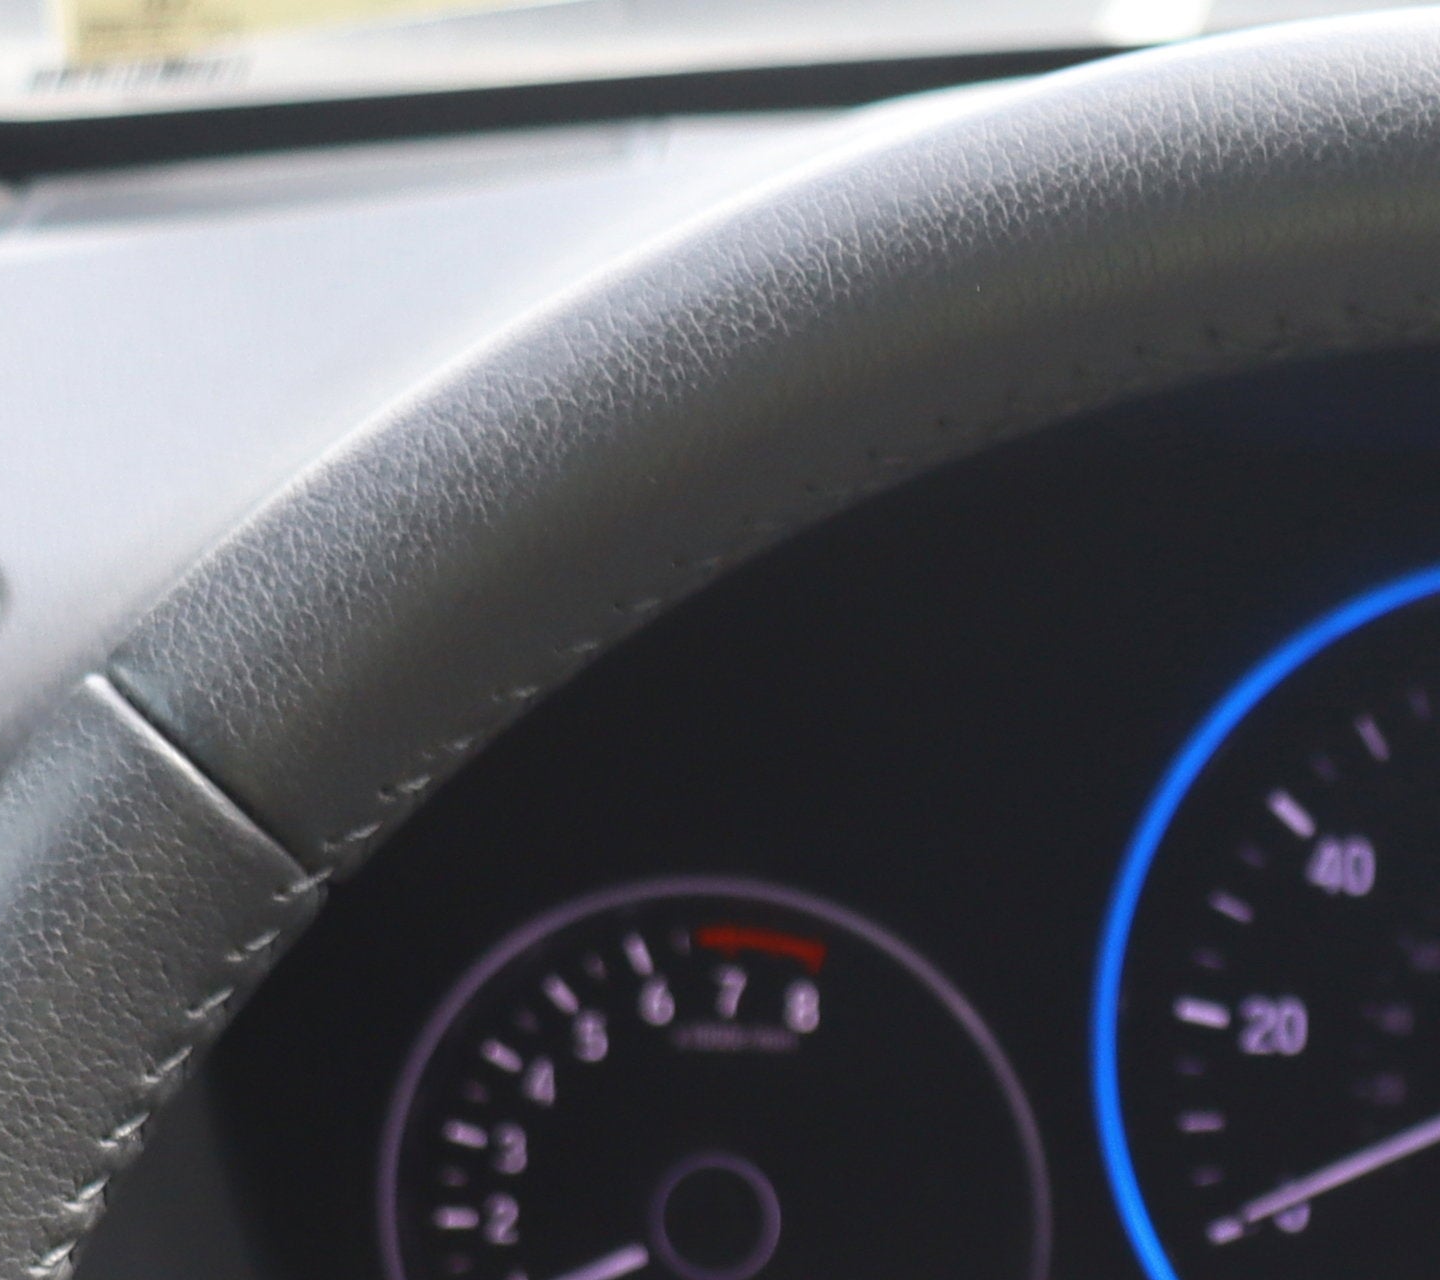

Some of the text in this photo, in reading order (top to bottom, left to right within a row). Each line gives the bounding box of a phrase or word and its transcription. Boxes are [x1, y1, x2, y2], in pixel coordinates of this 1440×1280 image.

[1308, 836, 1377, 897] 40
[641, 980, 676, 1026] 6
[716, 966, 748, 1018] 7
[785, 981, 822, 1033] 8
[1239, 996, 1310, 1057] 20
[486, 1194, 521, 1246] 2
